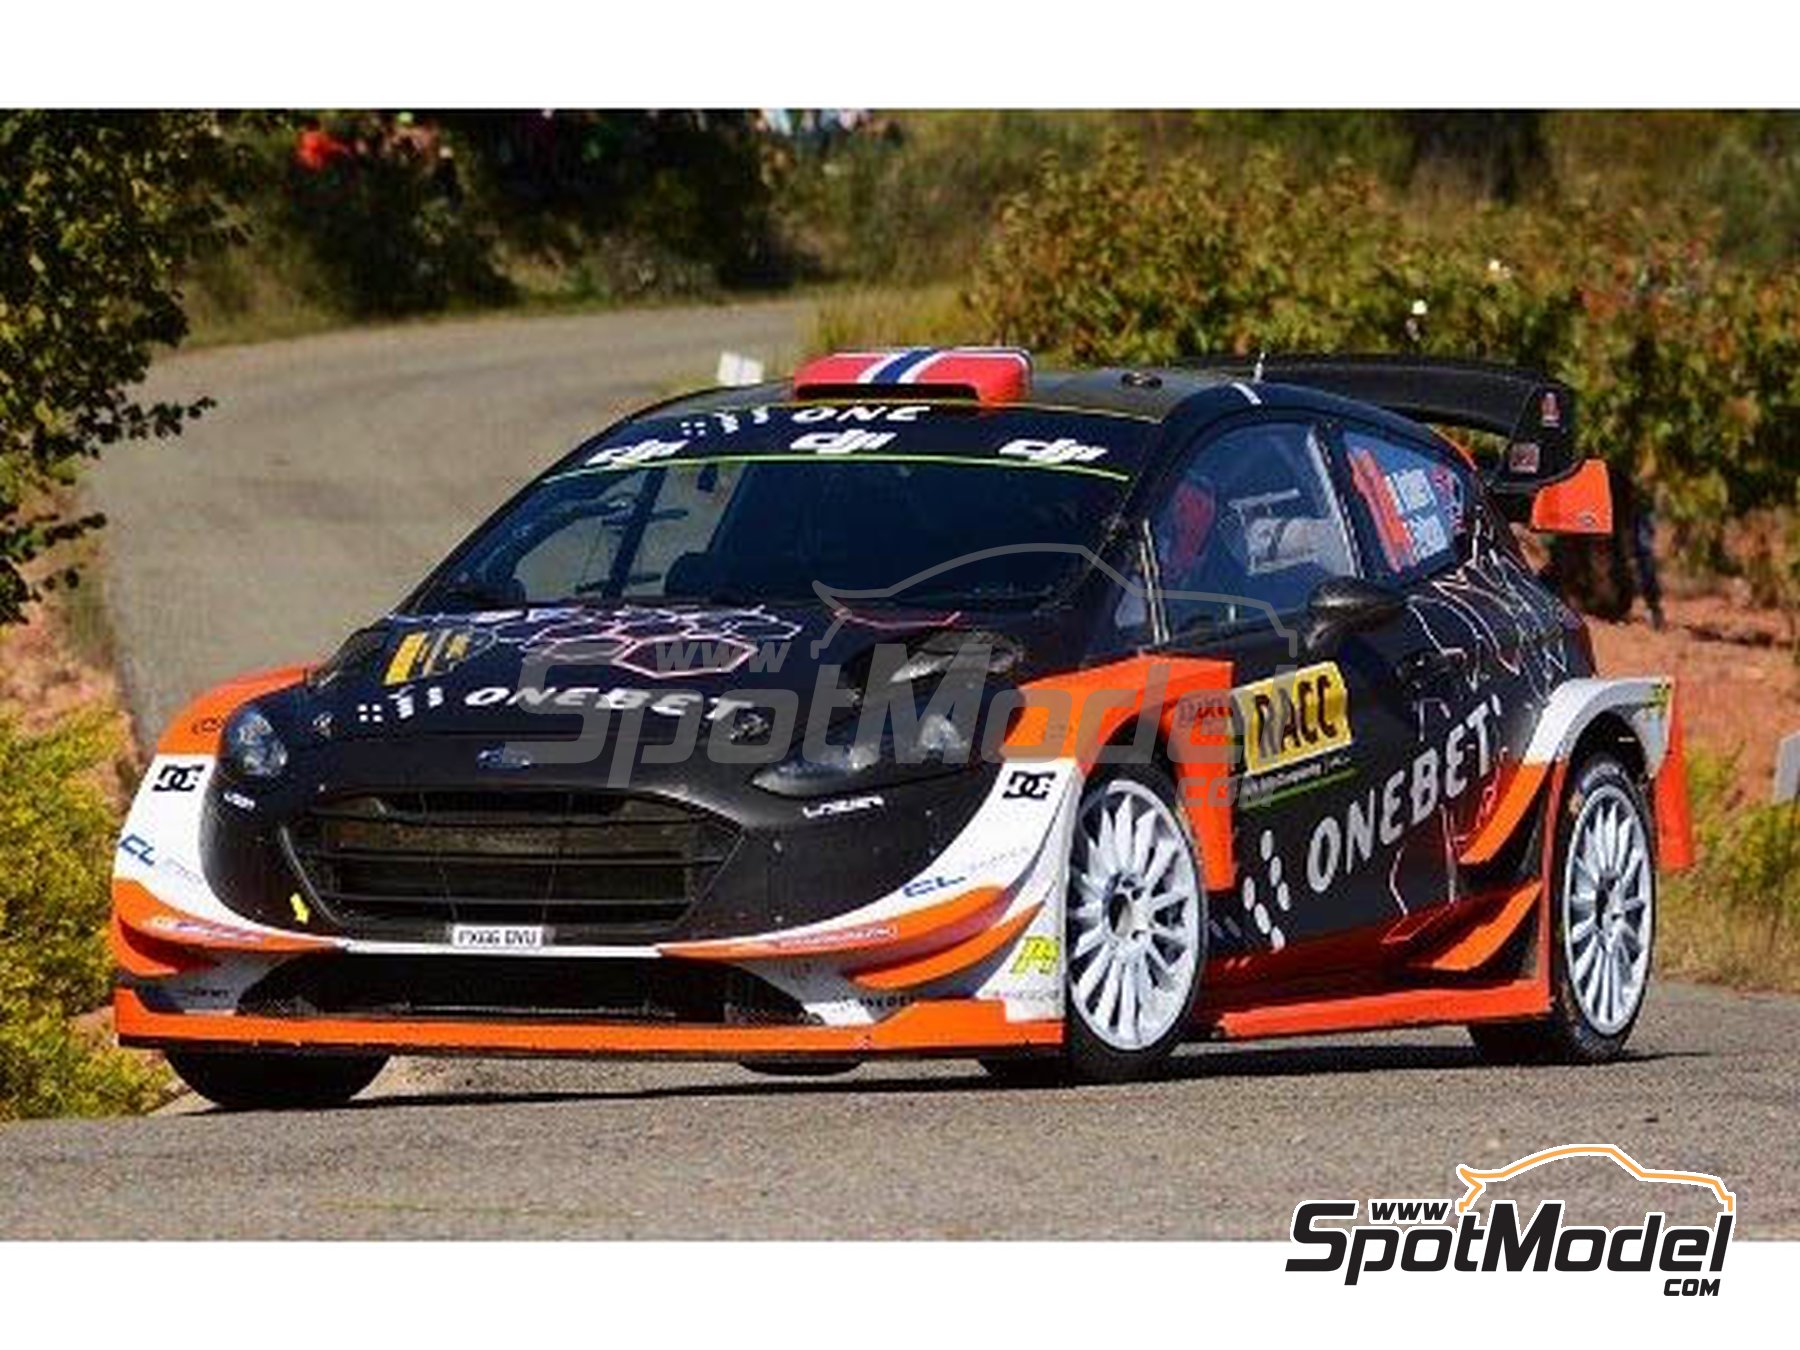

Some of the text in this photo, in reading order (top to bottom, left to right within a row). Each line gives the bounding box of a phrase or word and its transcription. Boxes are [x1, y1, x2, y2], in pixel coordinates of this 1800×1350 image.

[465, 686, 757, 720] ONEBET
[1254, 674, 1338, 759] RACC
[152, 764, 205, 792] DC
[1002, 771, 1056, 800] DC
[1306, 701, 1489, 893] ONEBET
